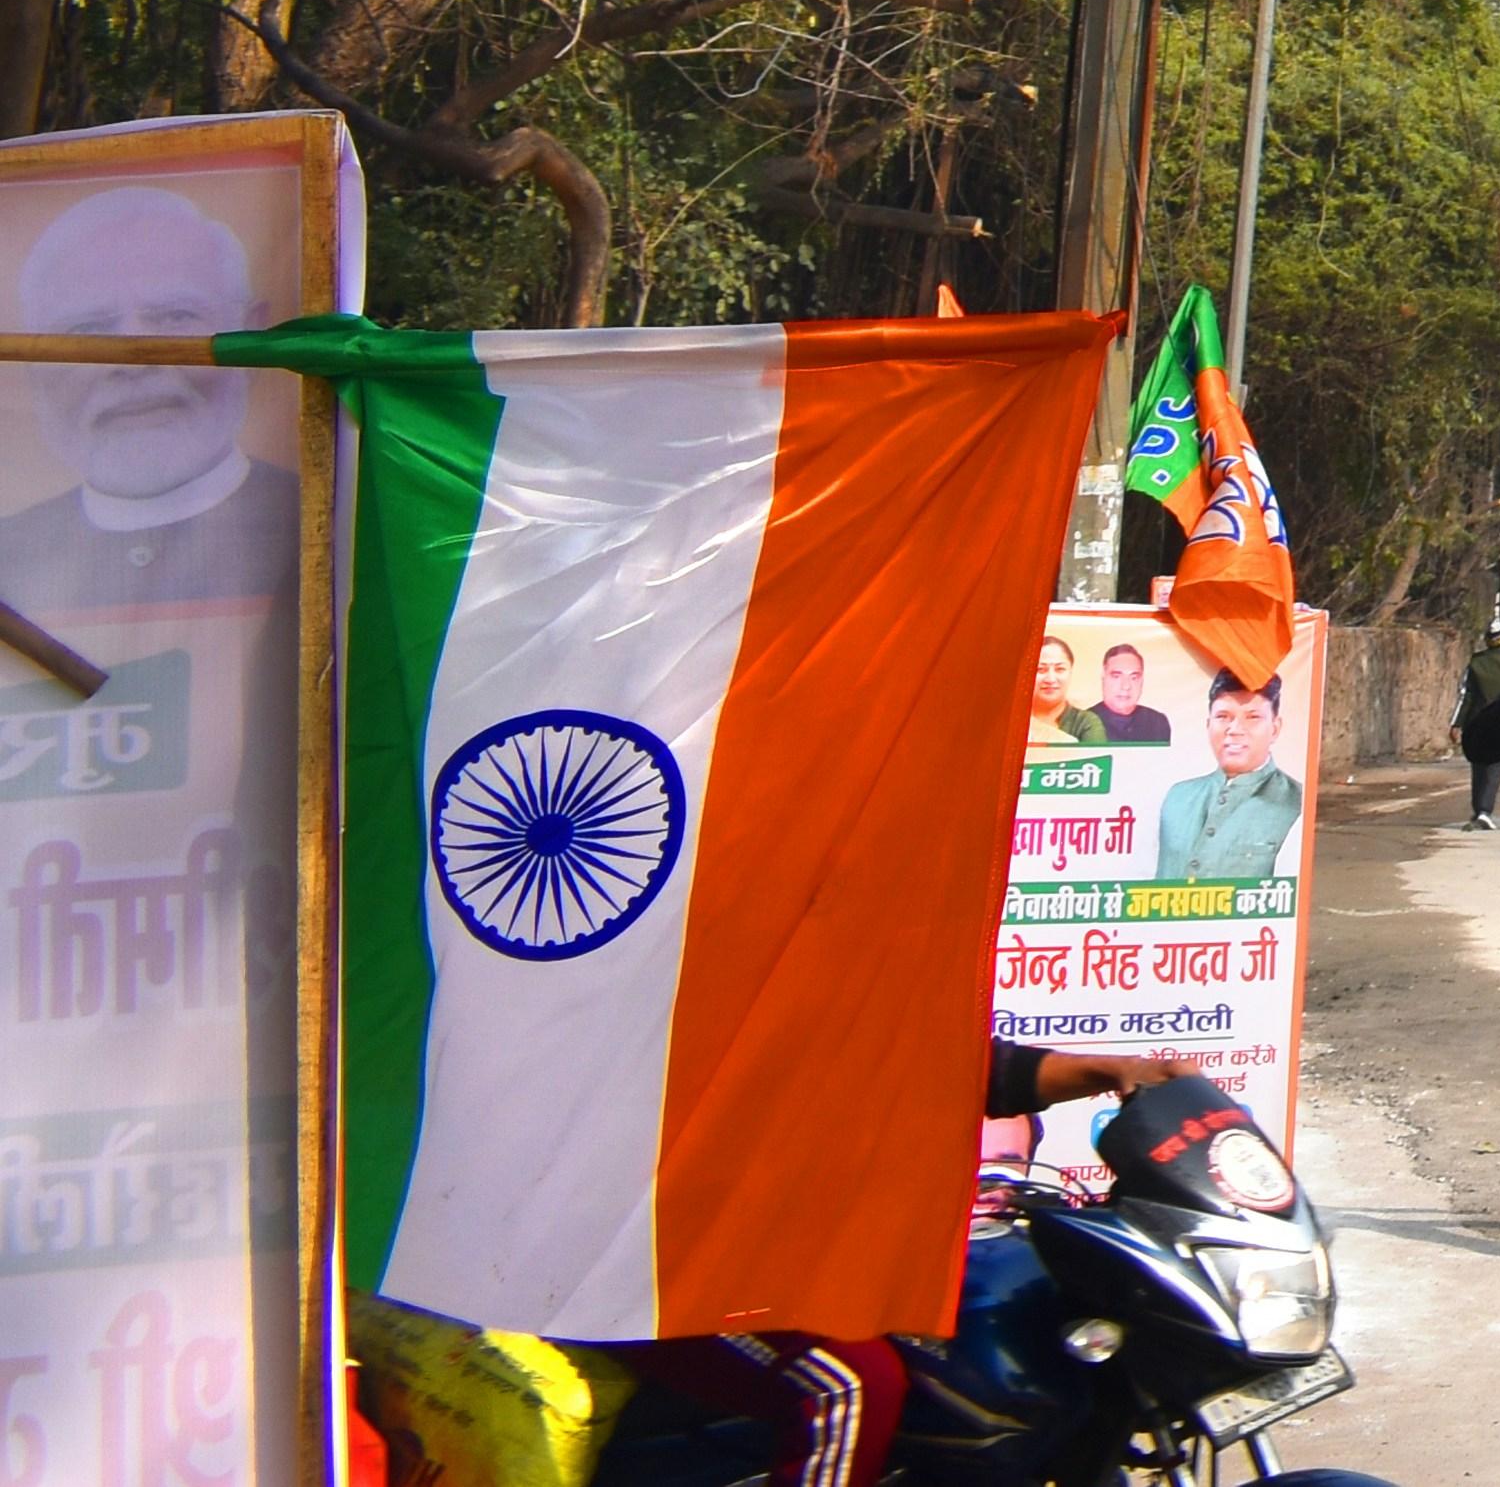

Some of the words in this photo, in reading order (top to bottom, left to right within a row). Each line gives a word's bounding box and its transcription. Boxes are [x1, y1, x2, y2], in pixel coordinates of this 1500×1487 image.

[1040, 762, 1103, 789] मंत्री
[1012, 817, 1047, 856] खा
[1050, 817, 1102, 871] गुप्ता
[1105, 805, 1136, 854] जी
[1103, 883, 1125, 918] से
[1126, 877, 1235, 918] जनसंवाद
[1236, 880, 1294, 914] करेंगी
[995, 933, 1072, 995] जेन्द्र
[1081, 928, 1143, 991] सिंह
[1153, 941, 1231, 986] यादव
[1241, 926, 1279, 982] जी
[1120, 1003, 1234, 1035] महरौली
[1230, 1044, 1278, 1066] करेंगे
